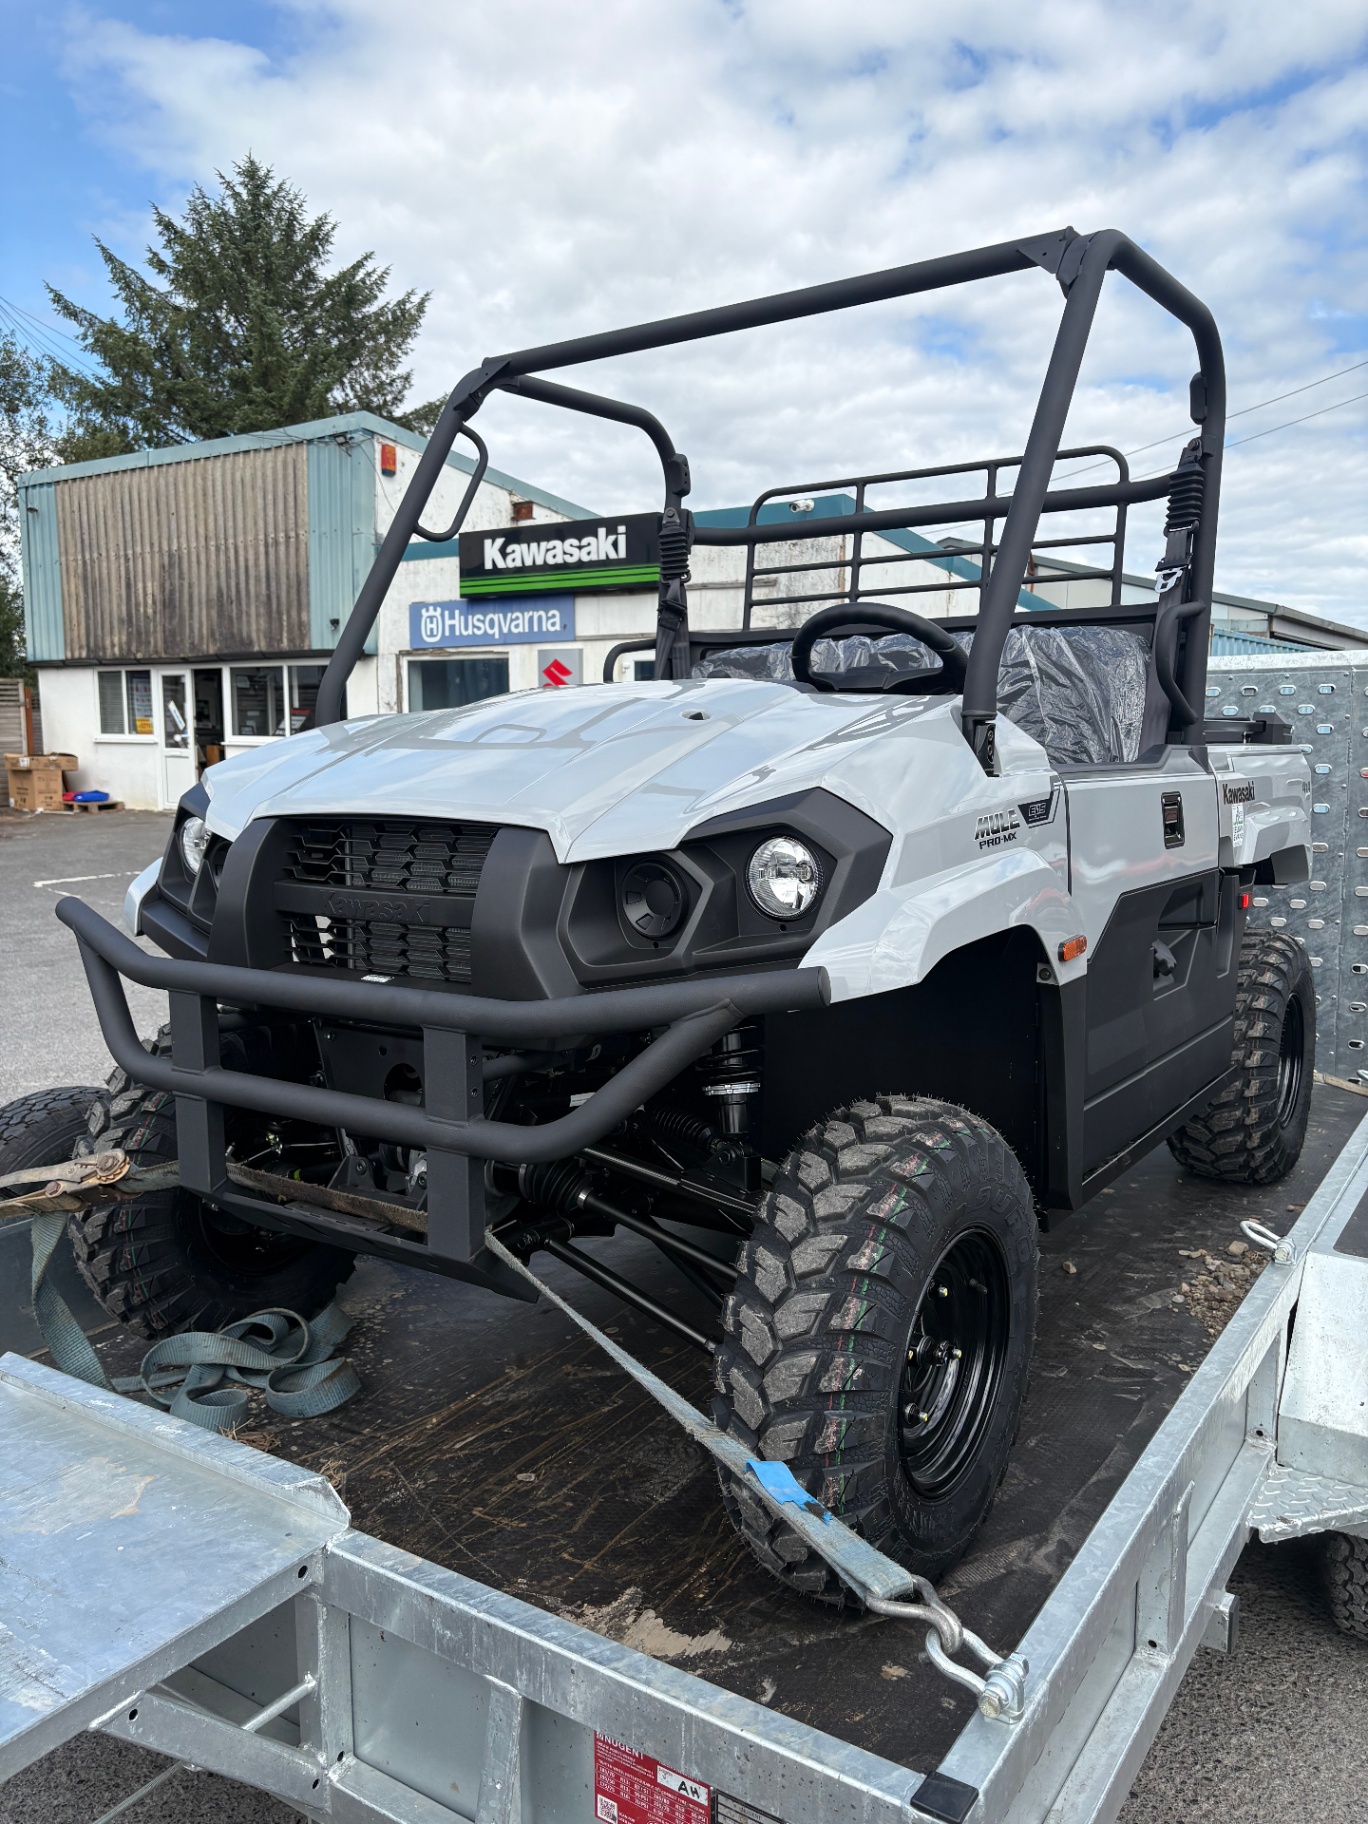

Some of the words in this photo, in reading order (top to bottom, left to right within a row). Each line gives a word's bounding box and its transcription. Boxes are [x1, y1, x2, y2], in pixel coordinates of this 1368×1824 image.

[484, 525, 626, 570] Kawasaki
[444, 609, 561, 639] Husqvarna
[1222, 780, 1255, 805] Kawasaki
[974, 808, 1020, 841] MULE
[979, 832, 1017, 850] PRO-MX
[677, 1780, 700, 1799] AH
